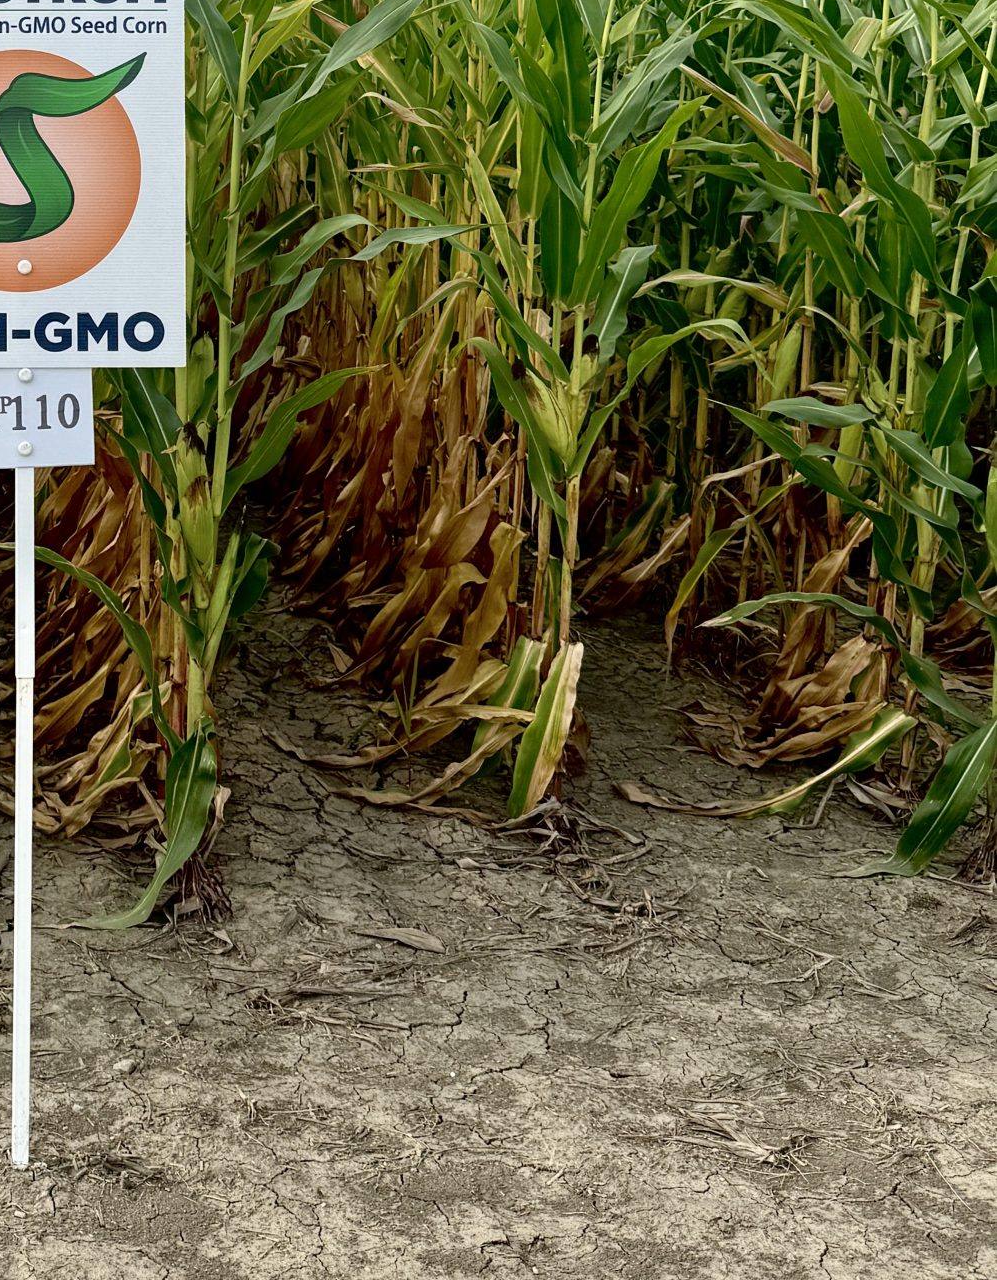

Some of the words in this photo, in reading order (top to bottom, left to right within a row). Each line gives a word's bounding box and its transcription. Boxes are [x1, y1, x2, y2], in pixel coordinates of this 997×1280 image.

[71, 16, 117, 34] Seed
[123, 16, 167, 34] Corn
[11, 393, 81, 431] 110
